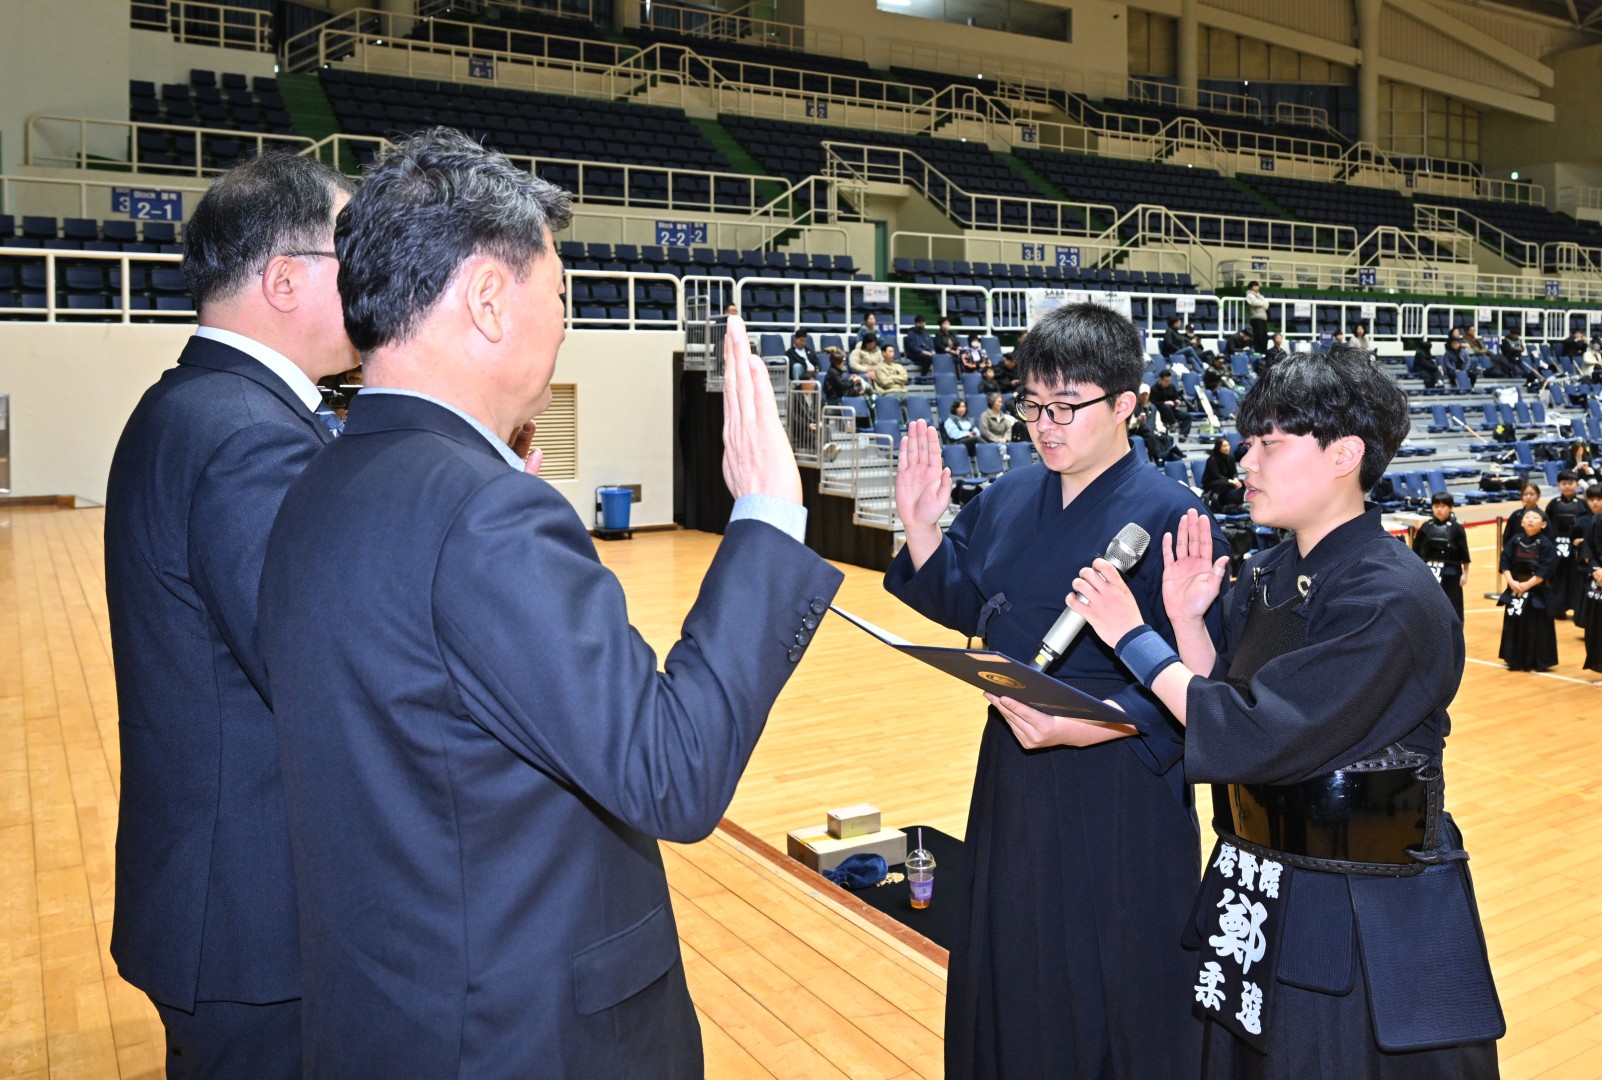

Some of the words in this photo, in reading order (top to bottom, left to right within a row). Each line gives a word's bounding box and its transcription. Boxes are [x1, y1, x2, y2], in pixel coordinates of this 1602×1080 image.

[137, 201, 173, 220] 2-1
[660, 231, 686, 246] 2-2
[1059, 254, 1078, 267] 2-3
[1361, 274, 1375, 285] 2-4
[1208, 888, 1268, 975] 鄭
